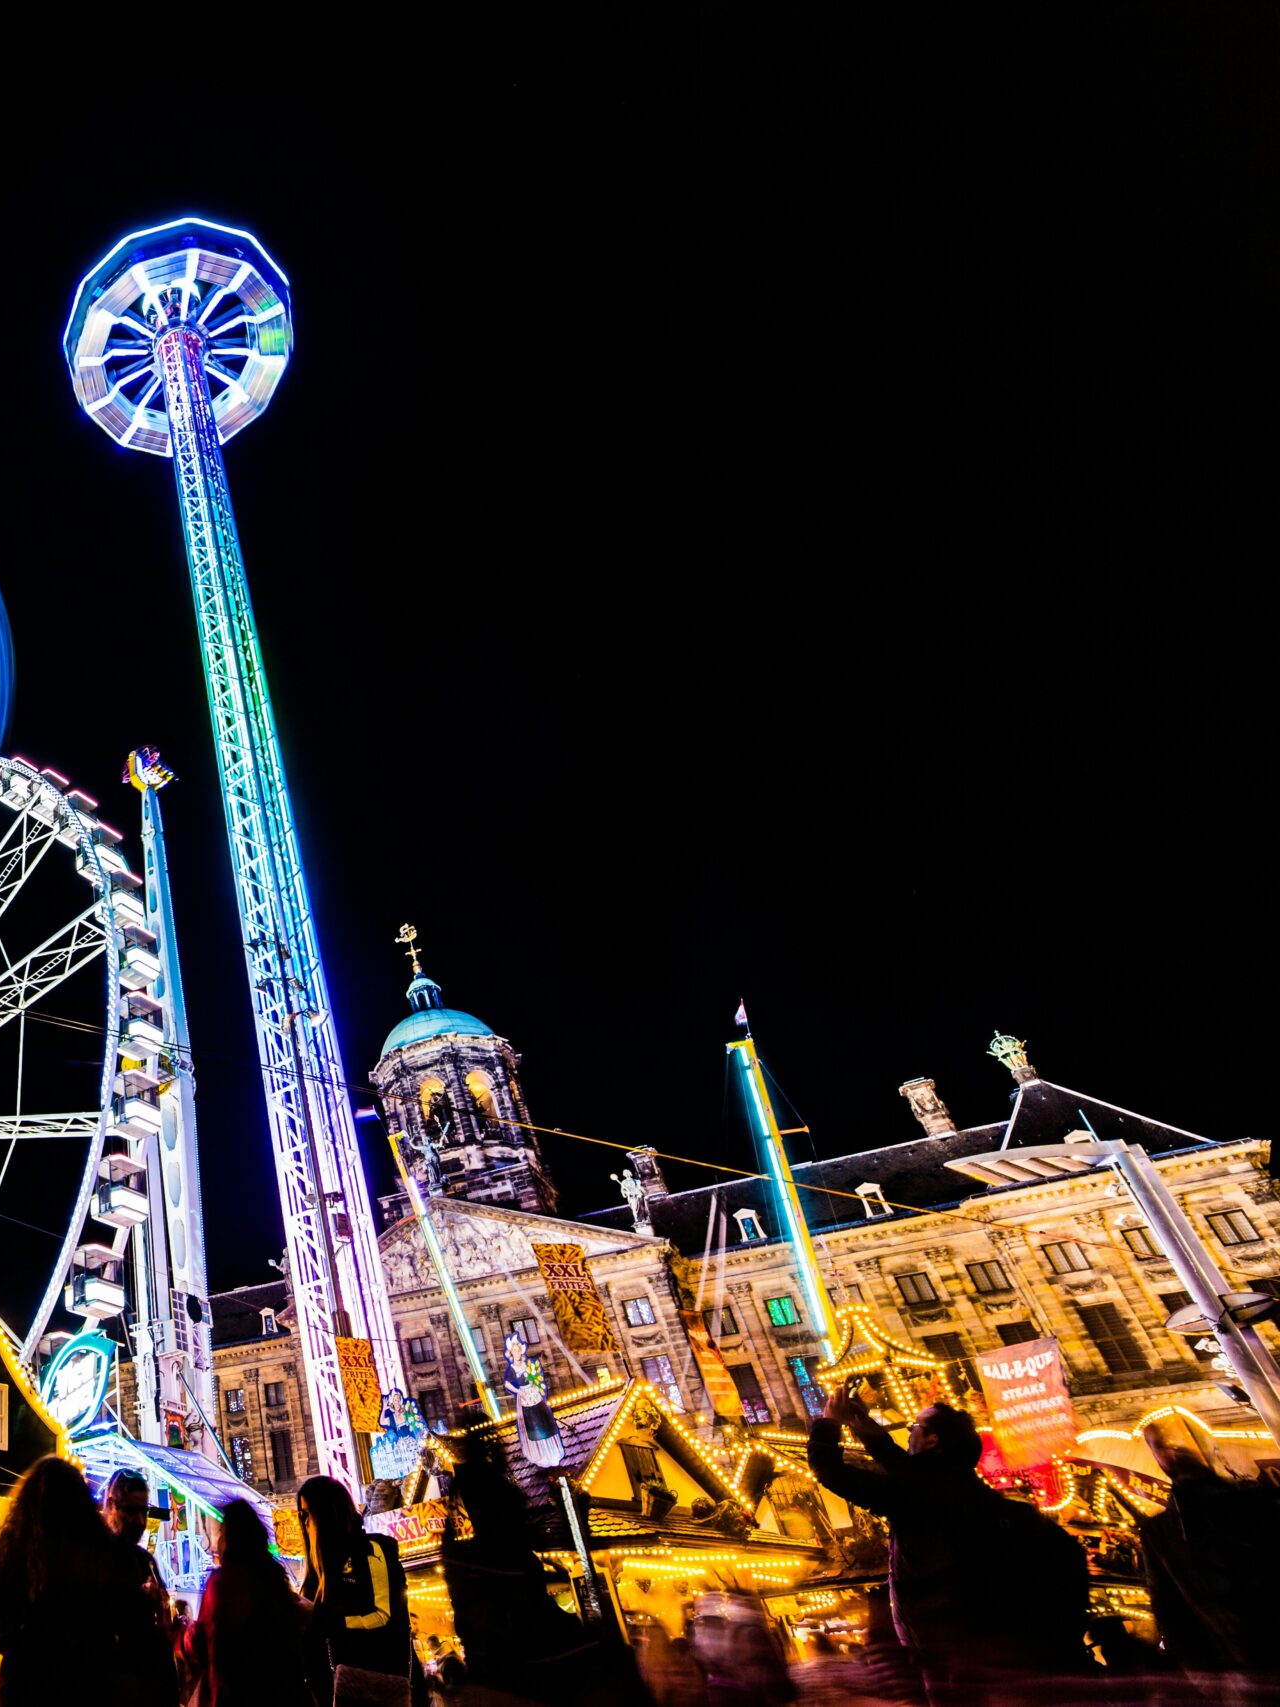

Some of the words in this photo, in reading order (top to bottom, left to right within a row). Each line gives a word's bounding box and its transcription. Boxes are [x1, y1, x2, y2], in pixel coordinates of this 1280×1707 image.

[543, 1263, 587, 1278] XXL
[549, 1281, 591, 1290] FRITES
[341, 1355, 372, 1368] XXL
[345, 1370, 374, 1379] FRITES
[1001, 1382, 1047, 1401] STEAKS
[993, 1395, 1064, 1422] BRATWURST
[1128, 1475, 1170, 1500] Bake
[387, 1516, 427, 1542] XXL
